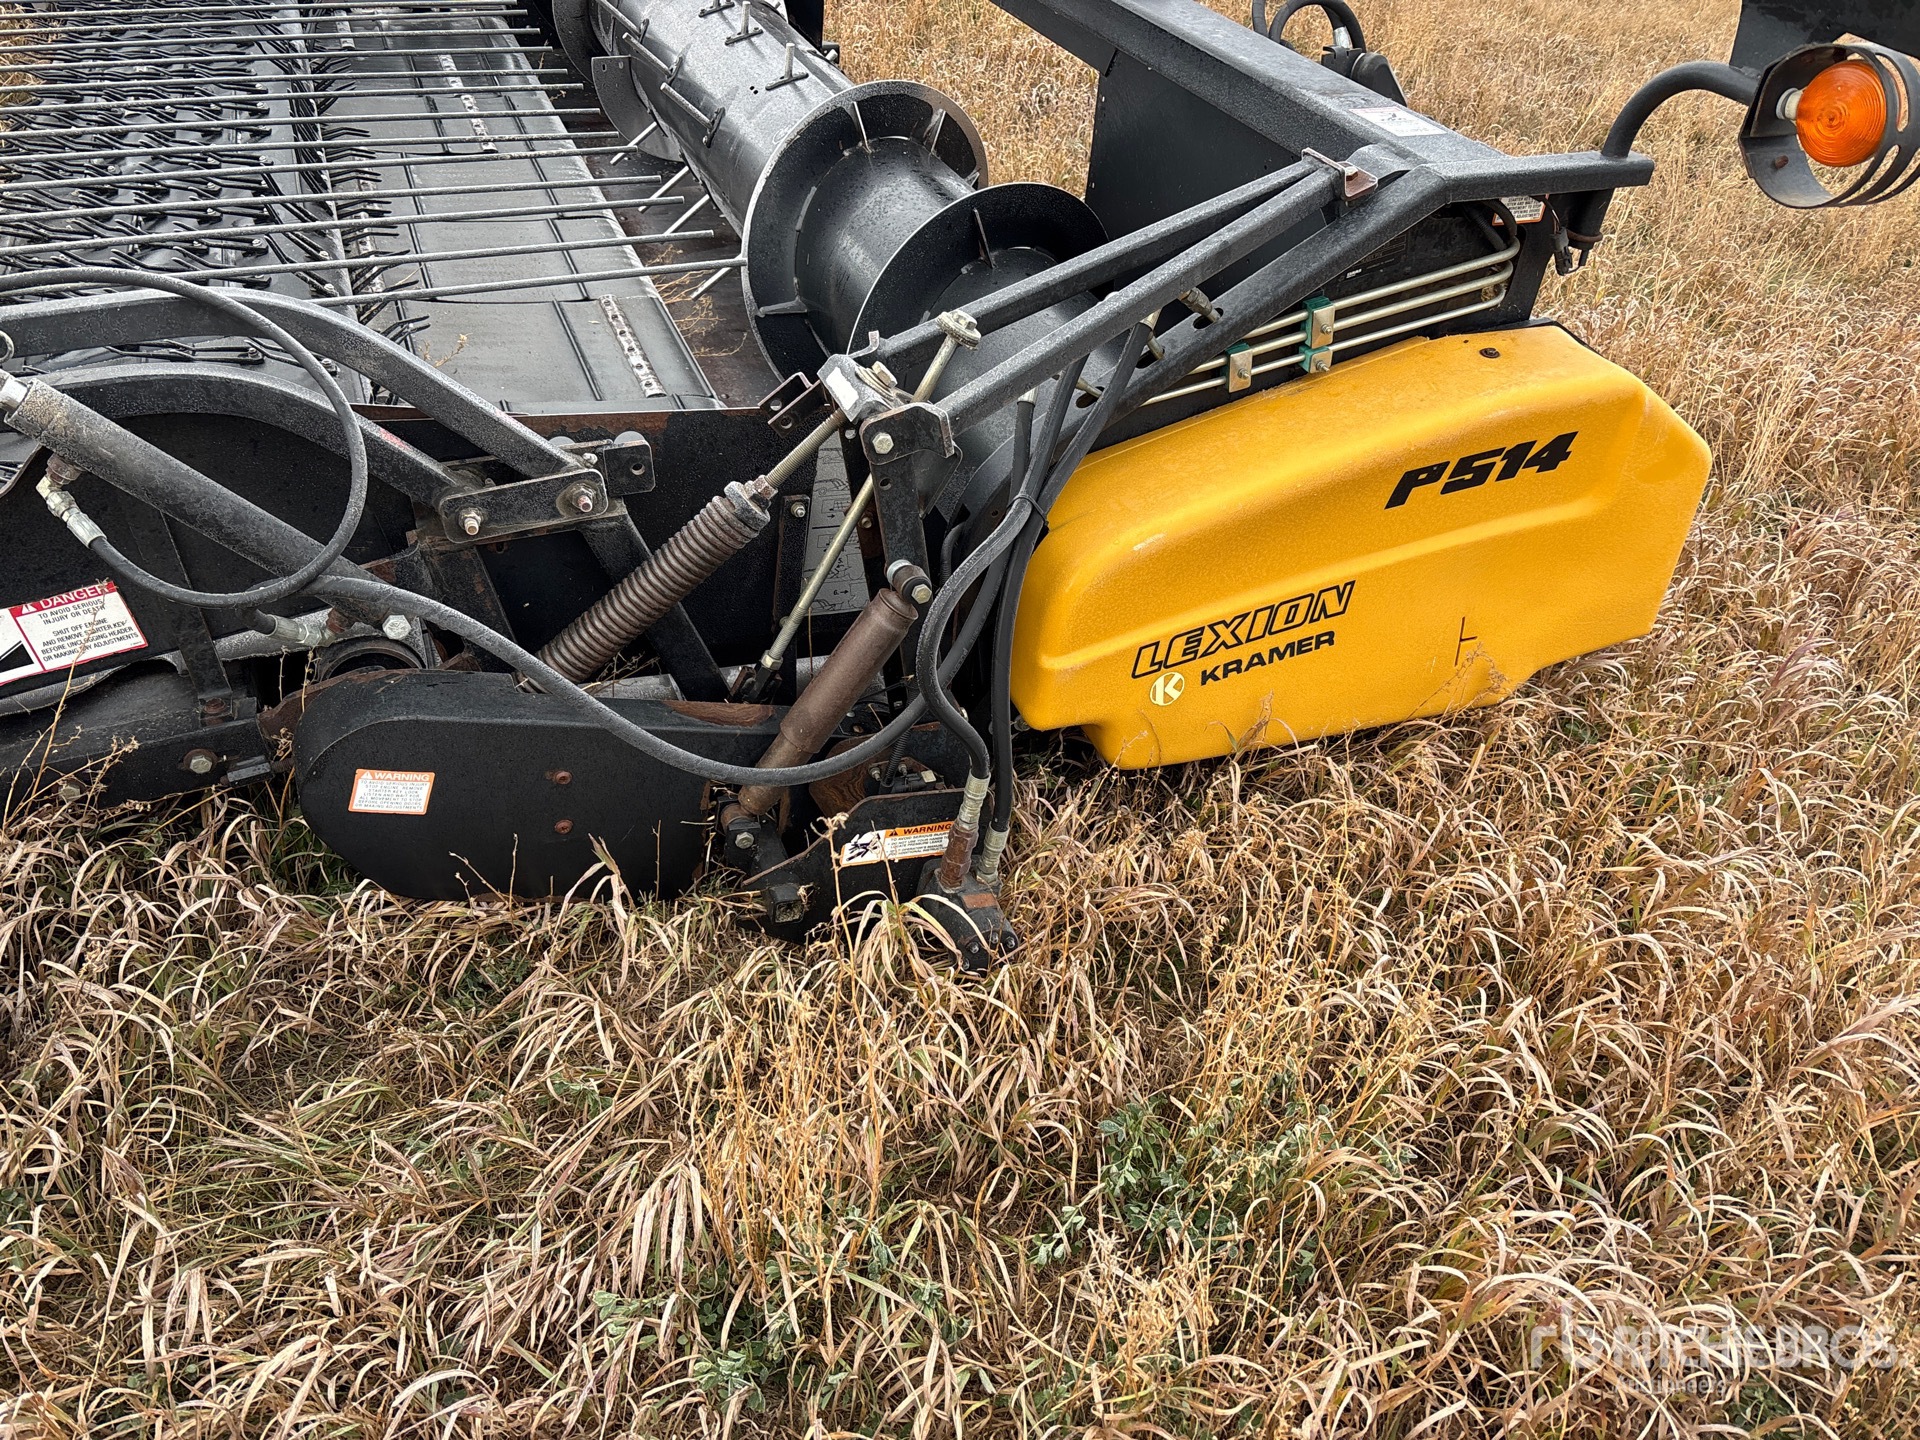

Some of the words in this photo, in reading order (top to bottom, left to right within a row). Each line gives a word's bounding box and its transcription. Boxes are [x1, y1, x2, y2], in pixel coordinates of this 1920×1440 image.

[1384, 431, 1579, 510] P514
[40, 583, 109, 609] DANGER
[38, 612, 48, 620] TO
[50, 606, 71, 617] AVOID
[72, 599, 104, 611] SERIOUS
[43, 614, 69, 625] INJURY
[71, 610, 81, 618] OR
[41, 644, 66, 655] BEFORE
[108, 626, 134, 636] HEADER
[42, 639, 56, 647] AND
[56, 631, 84, 643] REMOVE
[52, 627, 70, 637] SHUT
[71, 623, 83, 632] OFF
[1131, 580, 1356, 679] LEXION
[53, 647, 79, 659] MAKING
[80, 644, 92, 653] NY
[93, 631, 139, 648] ADJUSTMENTS
[1200, 630, 1335, 686] KRAMER
[374, 772, 430, 781] WARNING
[903, 823, 952, 835] WARNING
